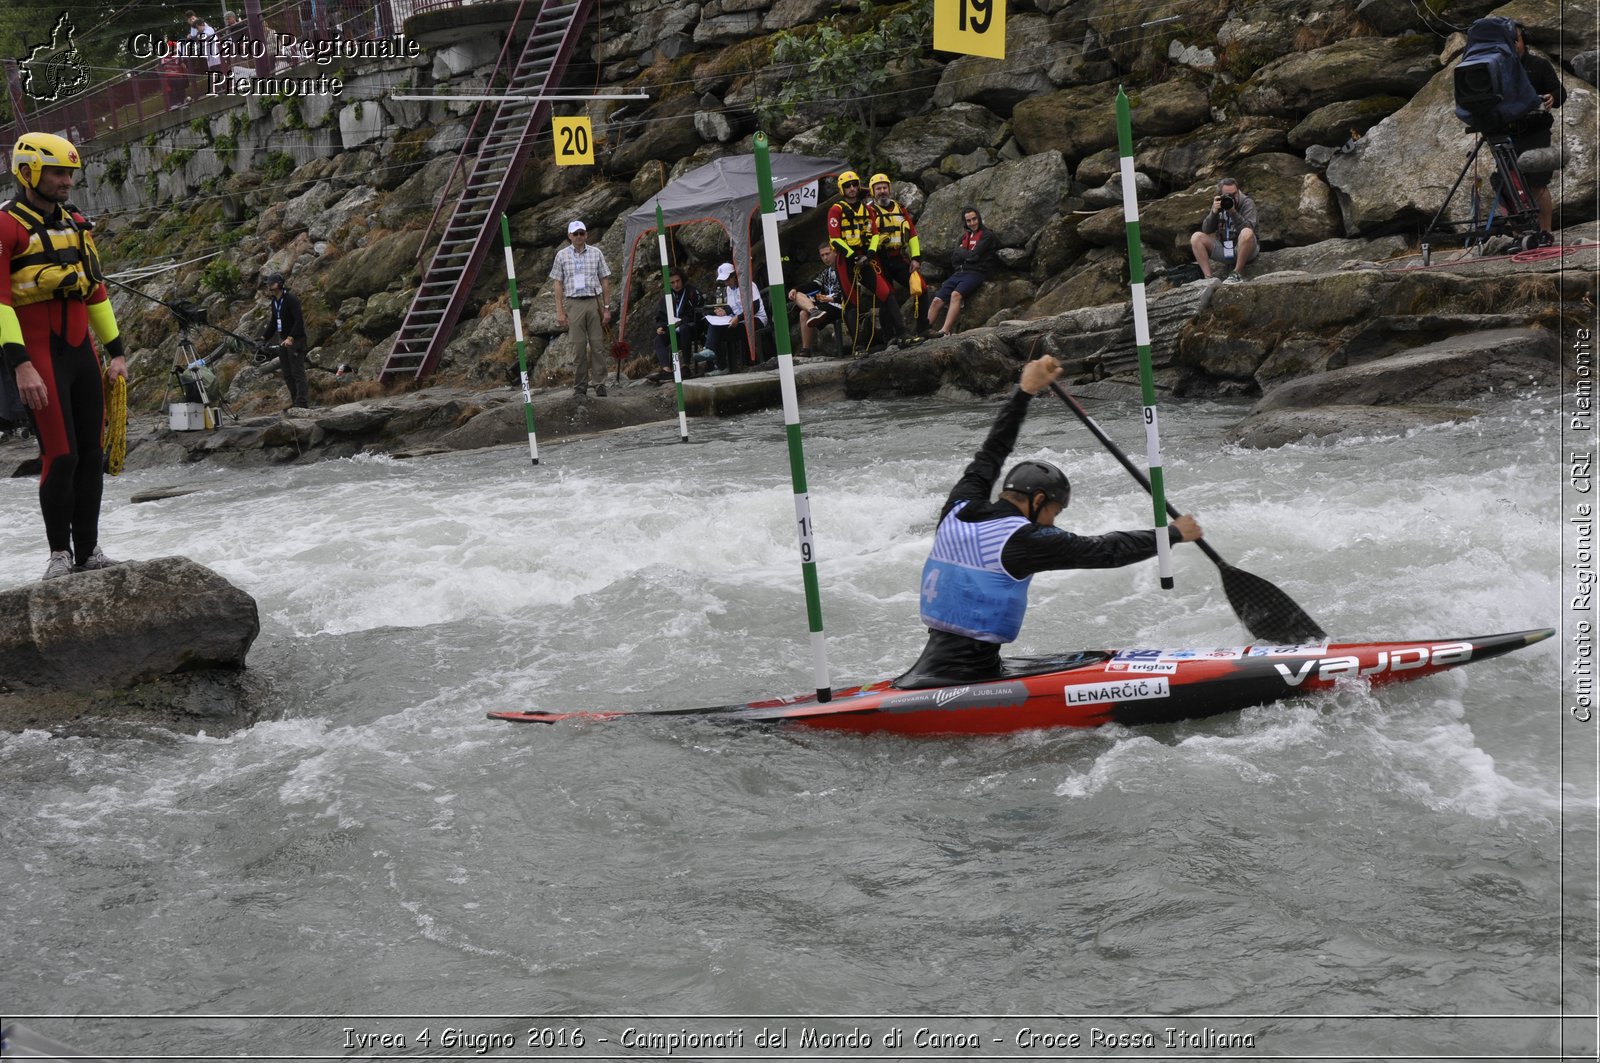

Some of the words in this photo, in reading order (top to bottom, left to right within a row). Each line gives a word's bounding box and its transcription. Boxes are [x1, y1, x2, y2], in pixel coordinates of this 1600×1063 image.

[959, 0, 993, 34] 19
[560, 126, 588, 155] 20
[789, 193, 801, 205] 23
[803, 187, 816, 199] 24
[1144, 407, 1154, 425] 9
[922, 568, 940, 604] 4
[1132, 663, 1174, 672] triglav
[890, 695, 929, 704] PIVOVARNA
[932, 686, 970, 706] Union
[973, 688, 1013, 696] LJUBLJANA
[1153, 683, 1167, 696] J.
